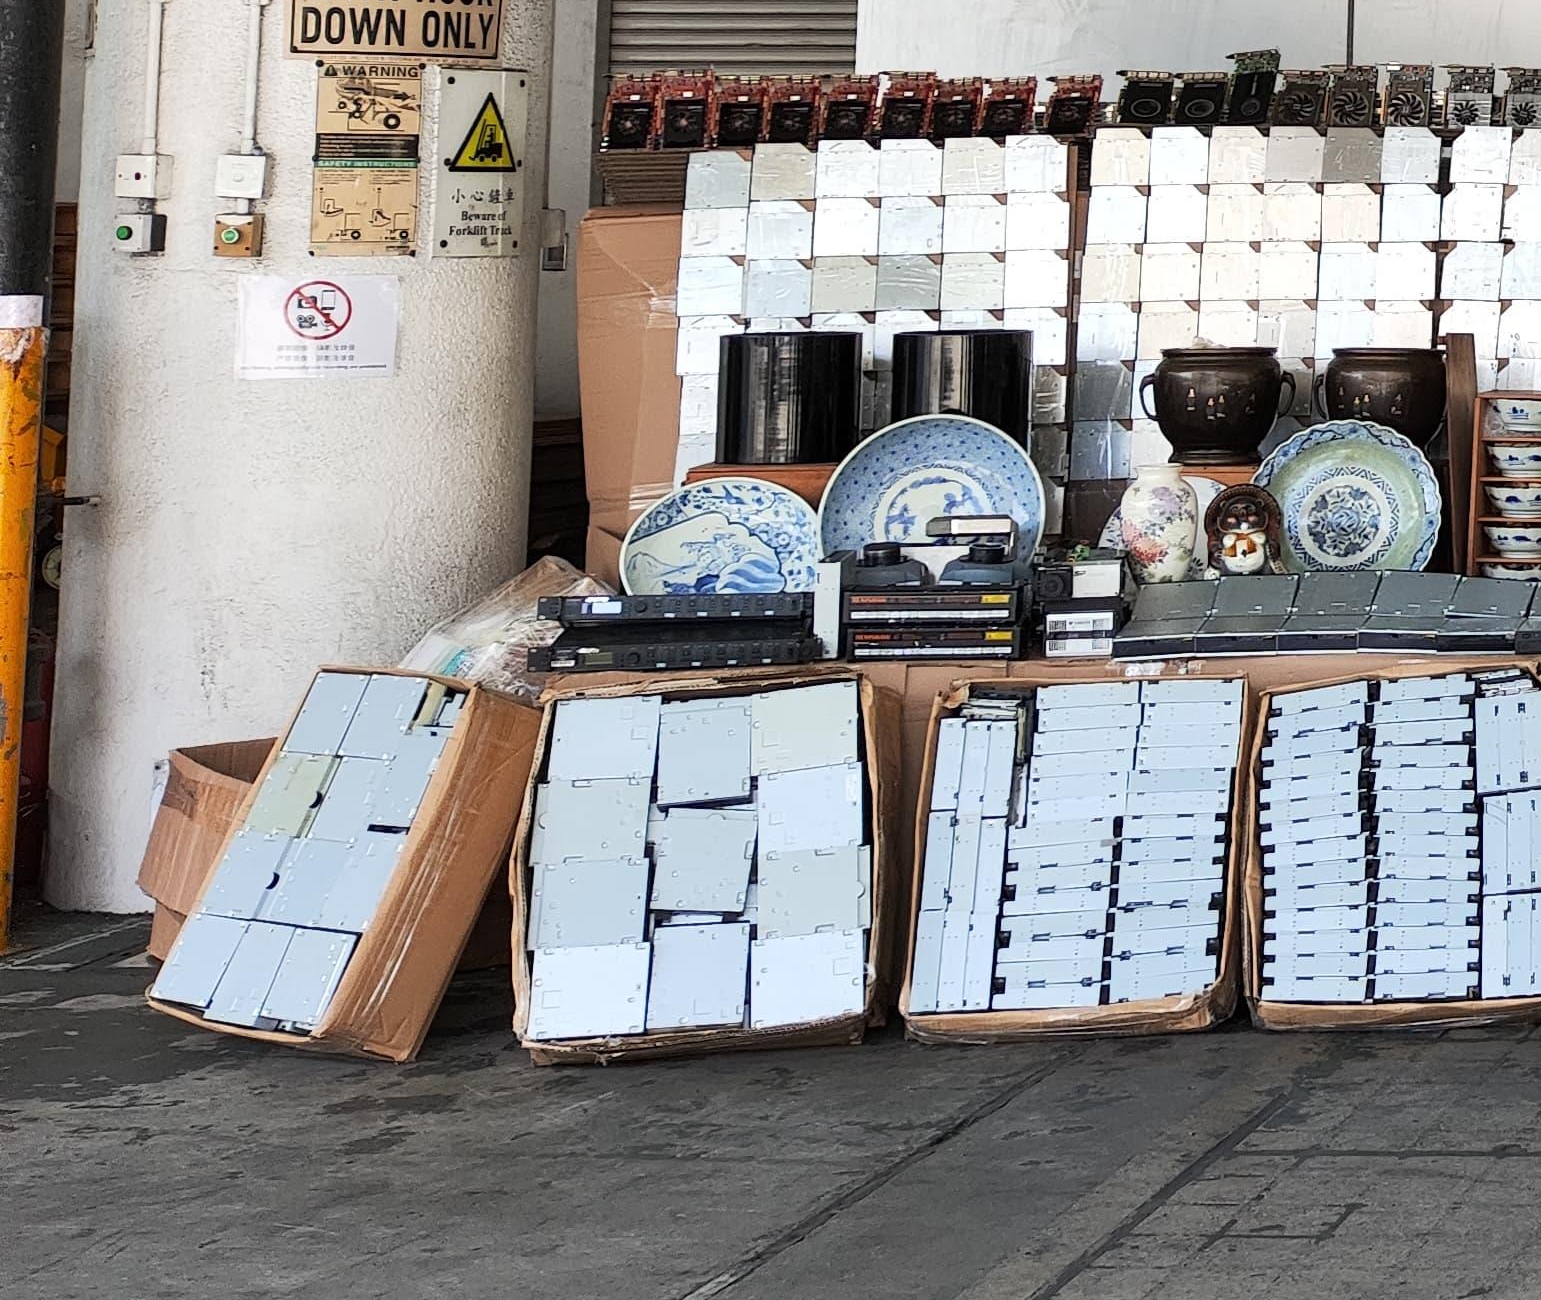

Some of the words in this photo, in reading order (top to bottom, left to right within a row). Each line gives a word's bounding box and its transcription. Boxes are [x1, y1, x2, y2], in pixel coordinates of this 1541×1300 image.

[301, 6, 406, 47] DOWN
[422, 10, 494, 50] ONLY
[342, 65, 419, 78] WARNING
[461, 210, 496, 221] Beware
[449, 225, 487, 236] Forklift
